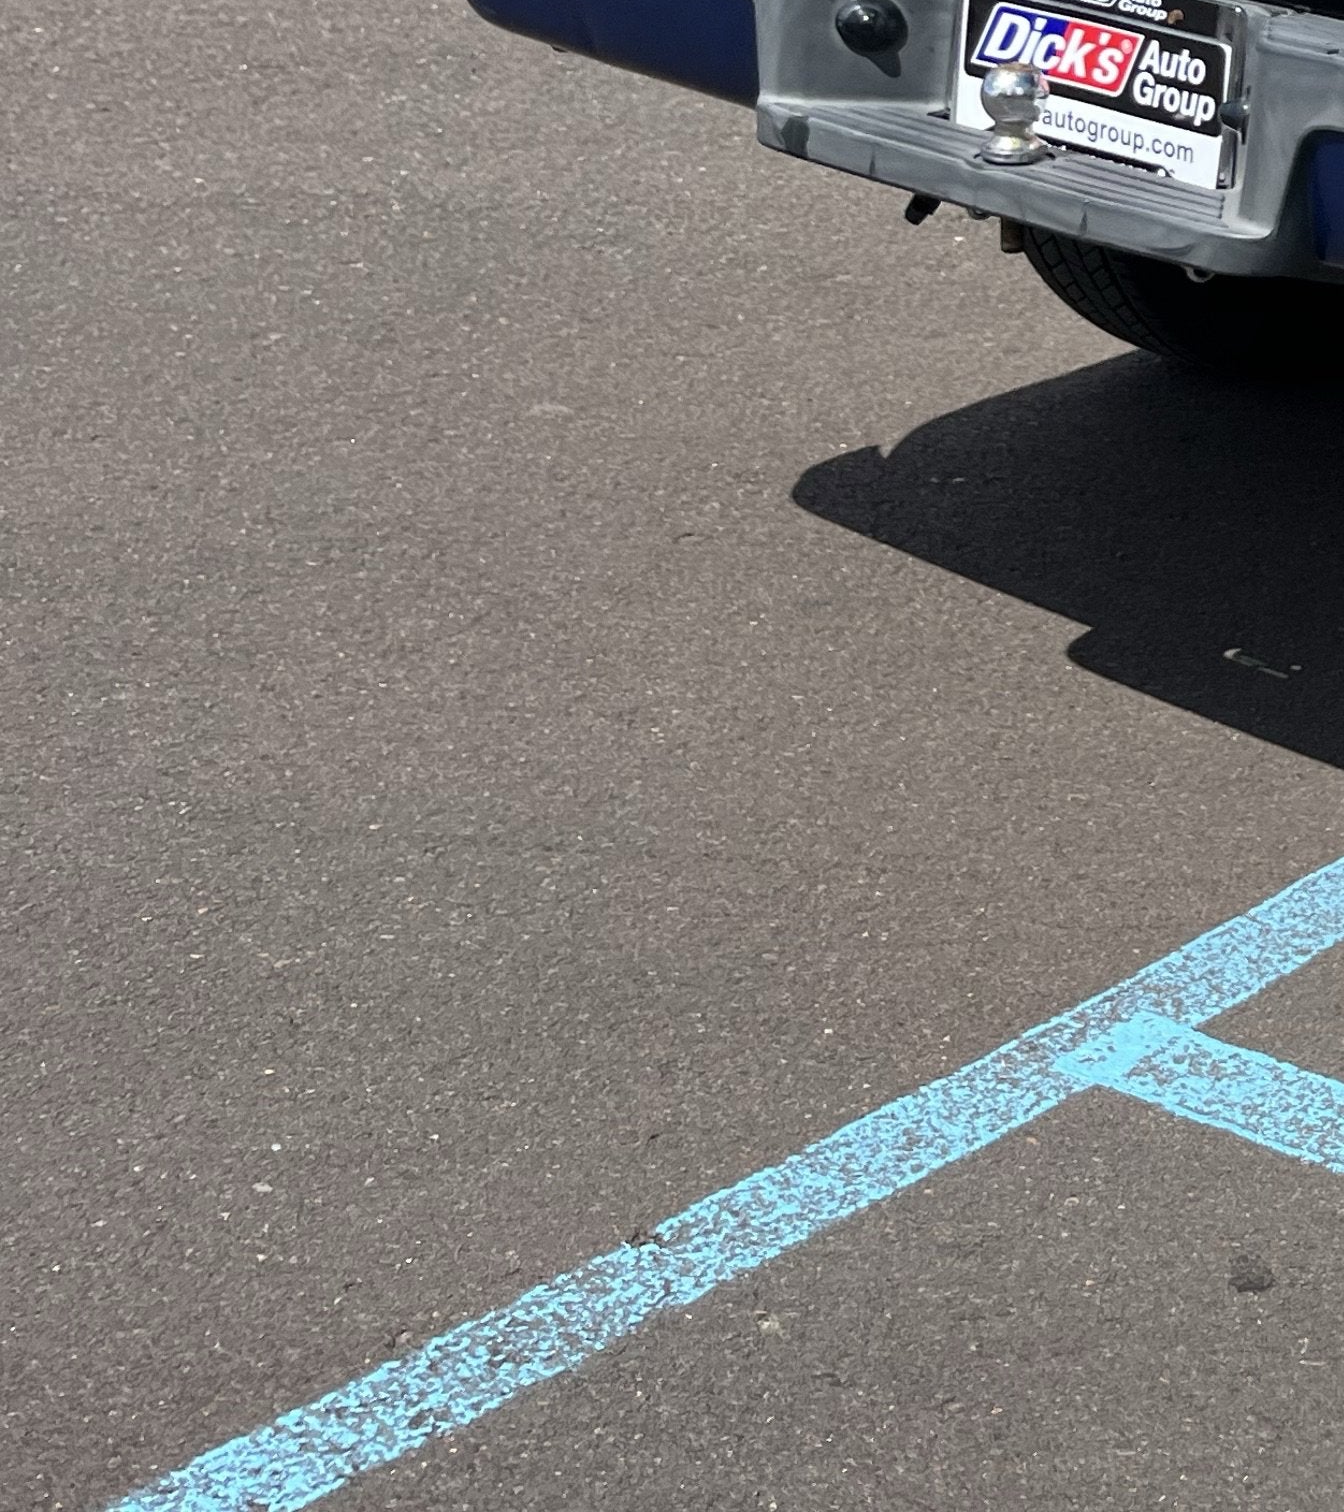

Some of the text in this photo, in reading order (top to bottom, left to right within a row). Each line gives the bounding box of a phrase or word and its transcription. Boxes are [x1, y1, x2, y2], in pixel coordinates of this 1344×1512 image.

[983, 11, 1123, 85] Dick's
[1138, 39, 1207, 86] Auto
[1132, 71, 1216, 127] Group
